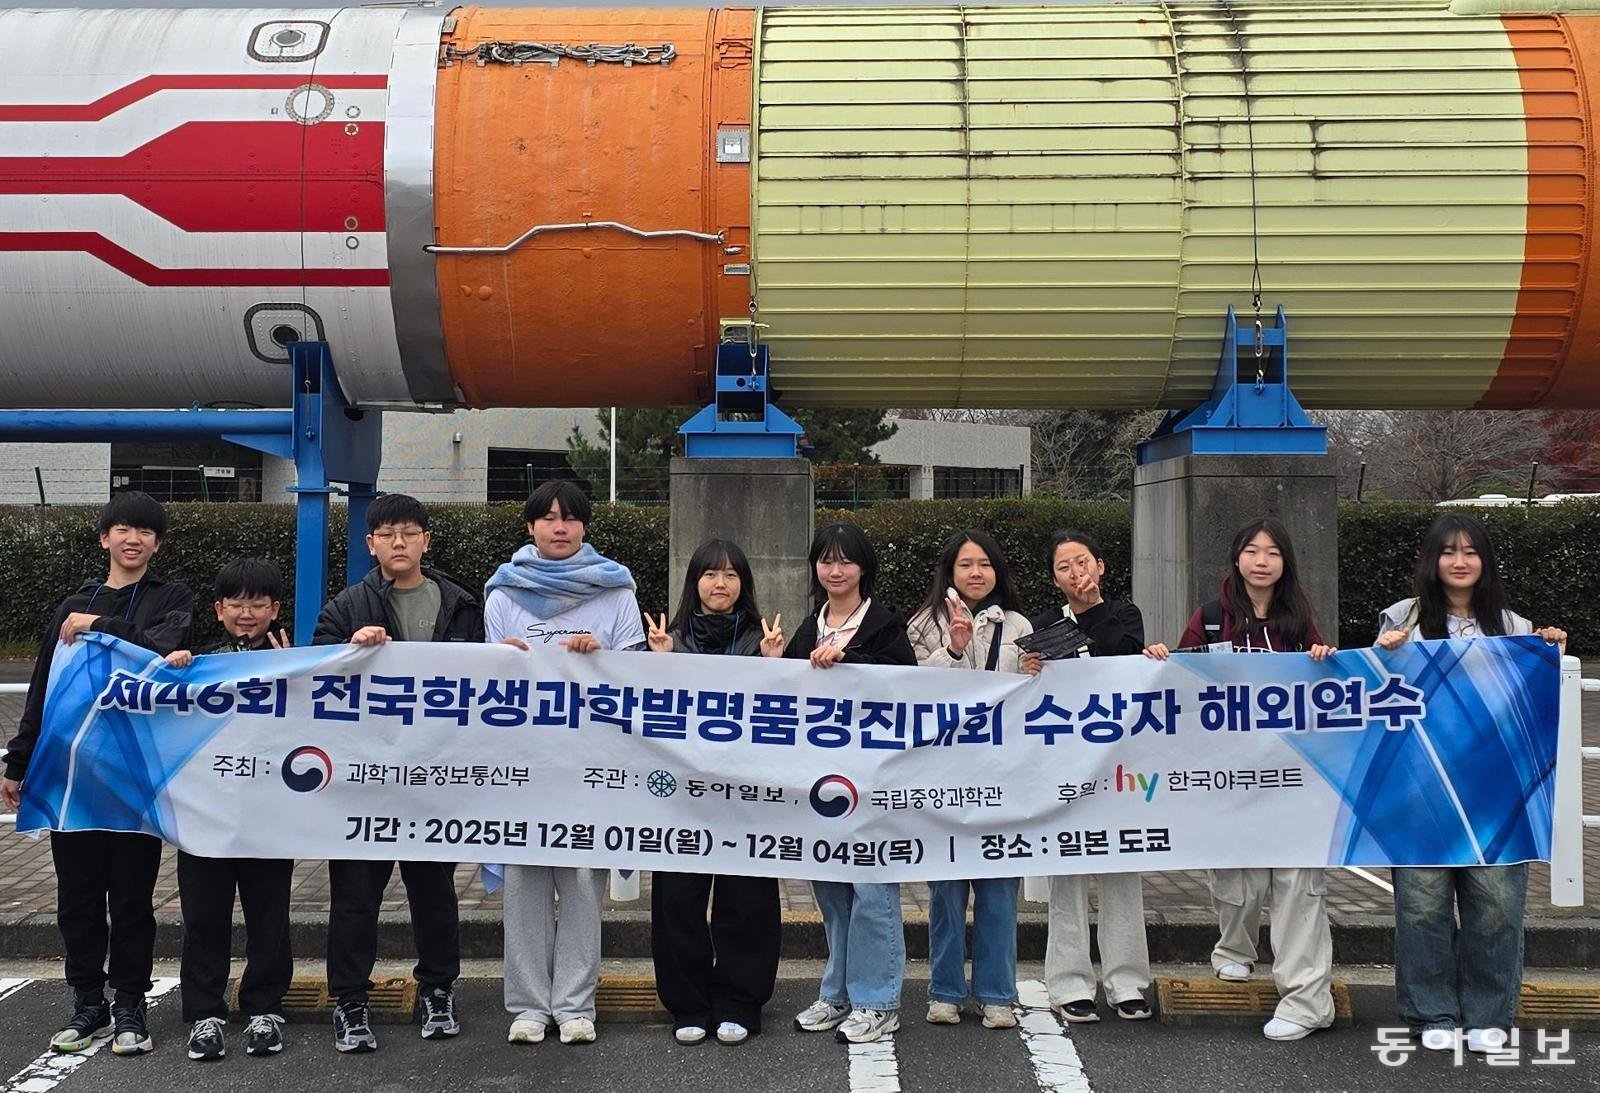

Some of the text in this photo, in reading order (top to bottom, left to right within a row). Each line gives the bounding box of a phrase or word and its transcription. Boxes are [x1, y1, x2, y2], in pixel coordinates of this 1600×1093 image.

[526, 622, 592, 644] Superman
[100, 672, 1424, 751] 제46회 전국학생과학발명품경진대회 수상자 해외연수
[212, 754, 258, 779] 주최
[346, 763, 530, 787] 과학기술정보통신부
[583, 766, 628, 791] 주관
[870, 786, 1004, 811] 국립중앙과학관
[1115, 763, 1160, 803] hy
[1167, 767, 1304, 792] 한국야쿠르트
[345, 816, 401, 843] 기간
[424, 818, 528, 847] 2025년
[537, 822, 596, 850] 12월
[604, 825, 714, 857] 01일(월)
[745, 833, 803, 862] 12월
[812, 838, 924, 867] 04일(목)
[980, 833, 1033, 861] 장소
[1056, 829, 1109, 857] 일본
[1118, 827, 1171, 854] 도쿄
